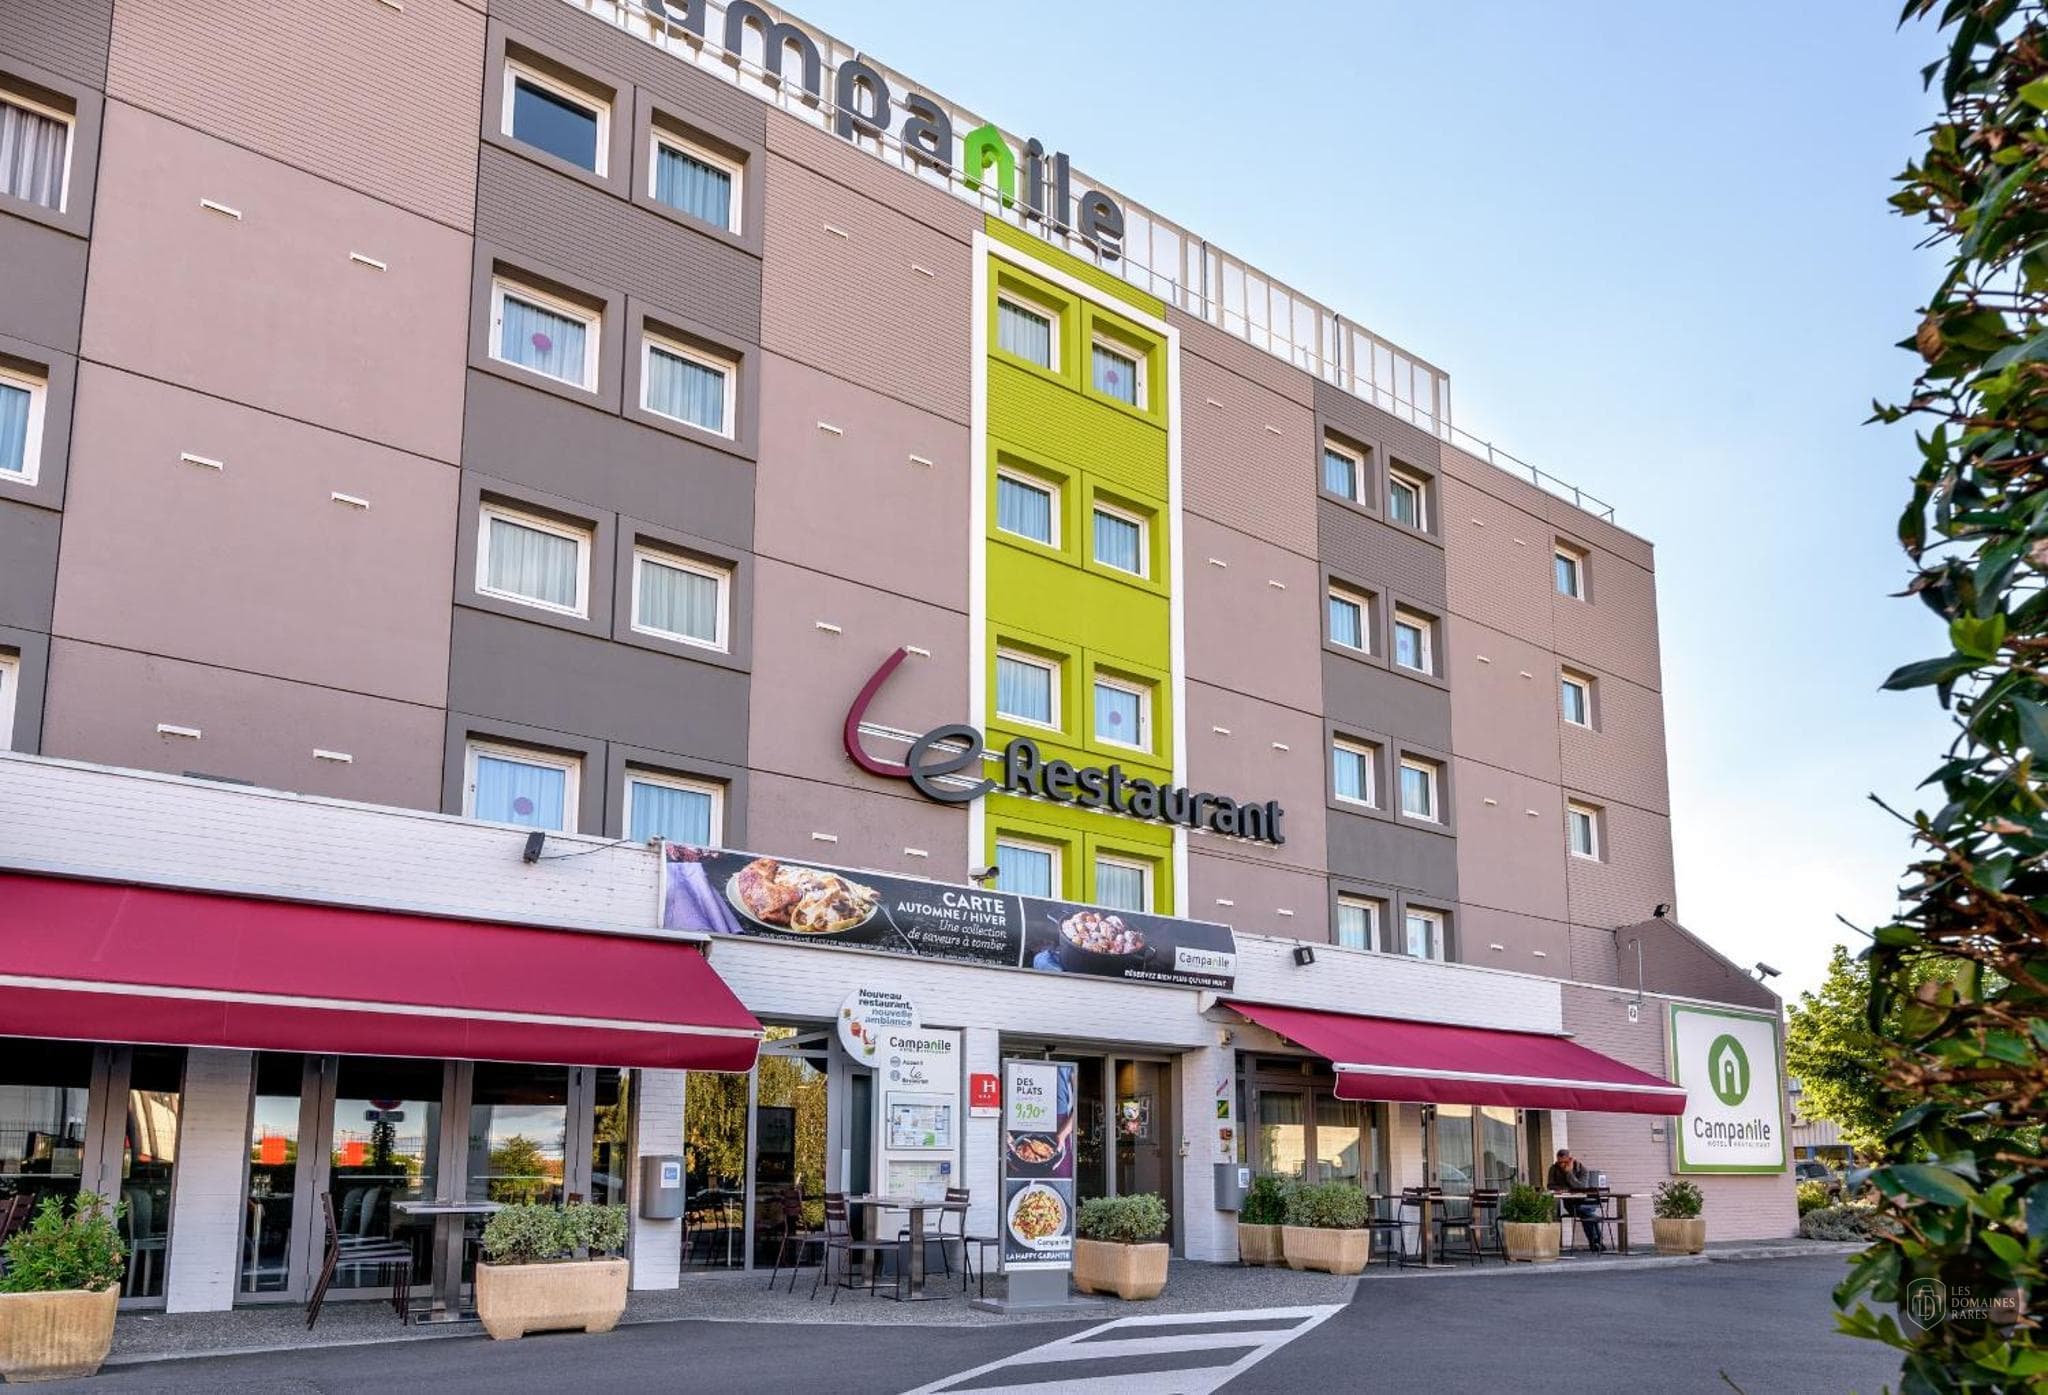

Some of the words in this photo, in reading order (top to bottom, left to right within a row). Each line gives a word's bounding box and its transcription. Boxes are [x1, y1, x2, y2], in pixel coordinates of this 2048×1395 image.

[843, 646, 997, 802] Le
[1003, 736, 1286, 845] Restaurant
[942, 891, 1006, 914] CARTE
[897, 901, 960, 921] AUTOMNE
[970, 912, 1006, 927] HIVER
[939, 919, 959, 933] Une
[961, 924, 1007, 939] collection
[907, 927, 921, 940] de
[922, 932, 960, 946] saveurs
[962, 934, 970, 947] à
[971, 938, 1007, 951] tomber
[1179, 952, 1230, 969] Campanile
[859, 988, 902, 1000] Nouveau
[859, 999, 913, 1011] restaurant,
[864, 1016, 913, 1027] ambiance
[871, 1008, 913, 1019] nouvelle
[889, 1036, 951, 1052] Campanile
[983, 1080, 996, 1093] H
[1016, 1077, 1034, 1086] DES
[1016, 1086, 1043, 1096] PLATS
[1694, 1116, 1770, 1147] Campanile
